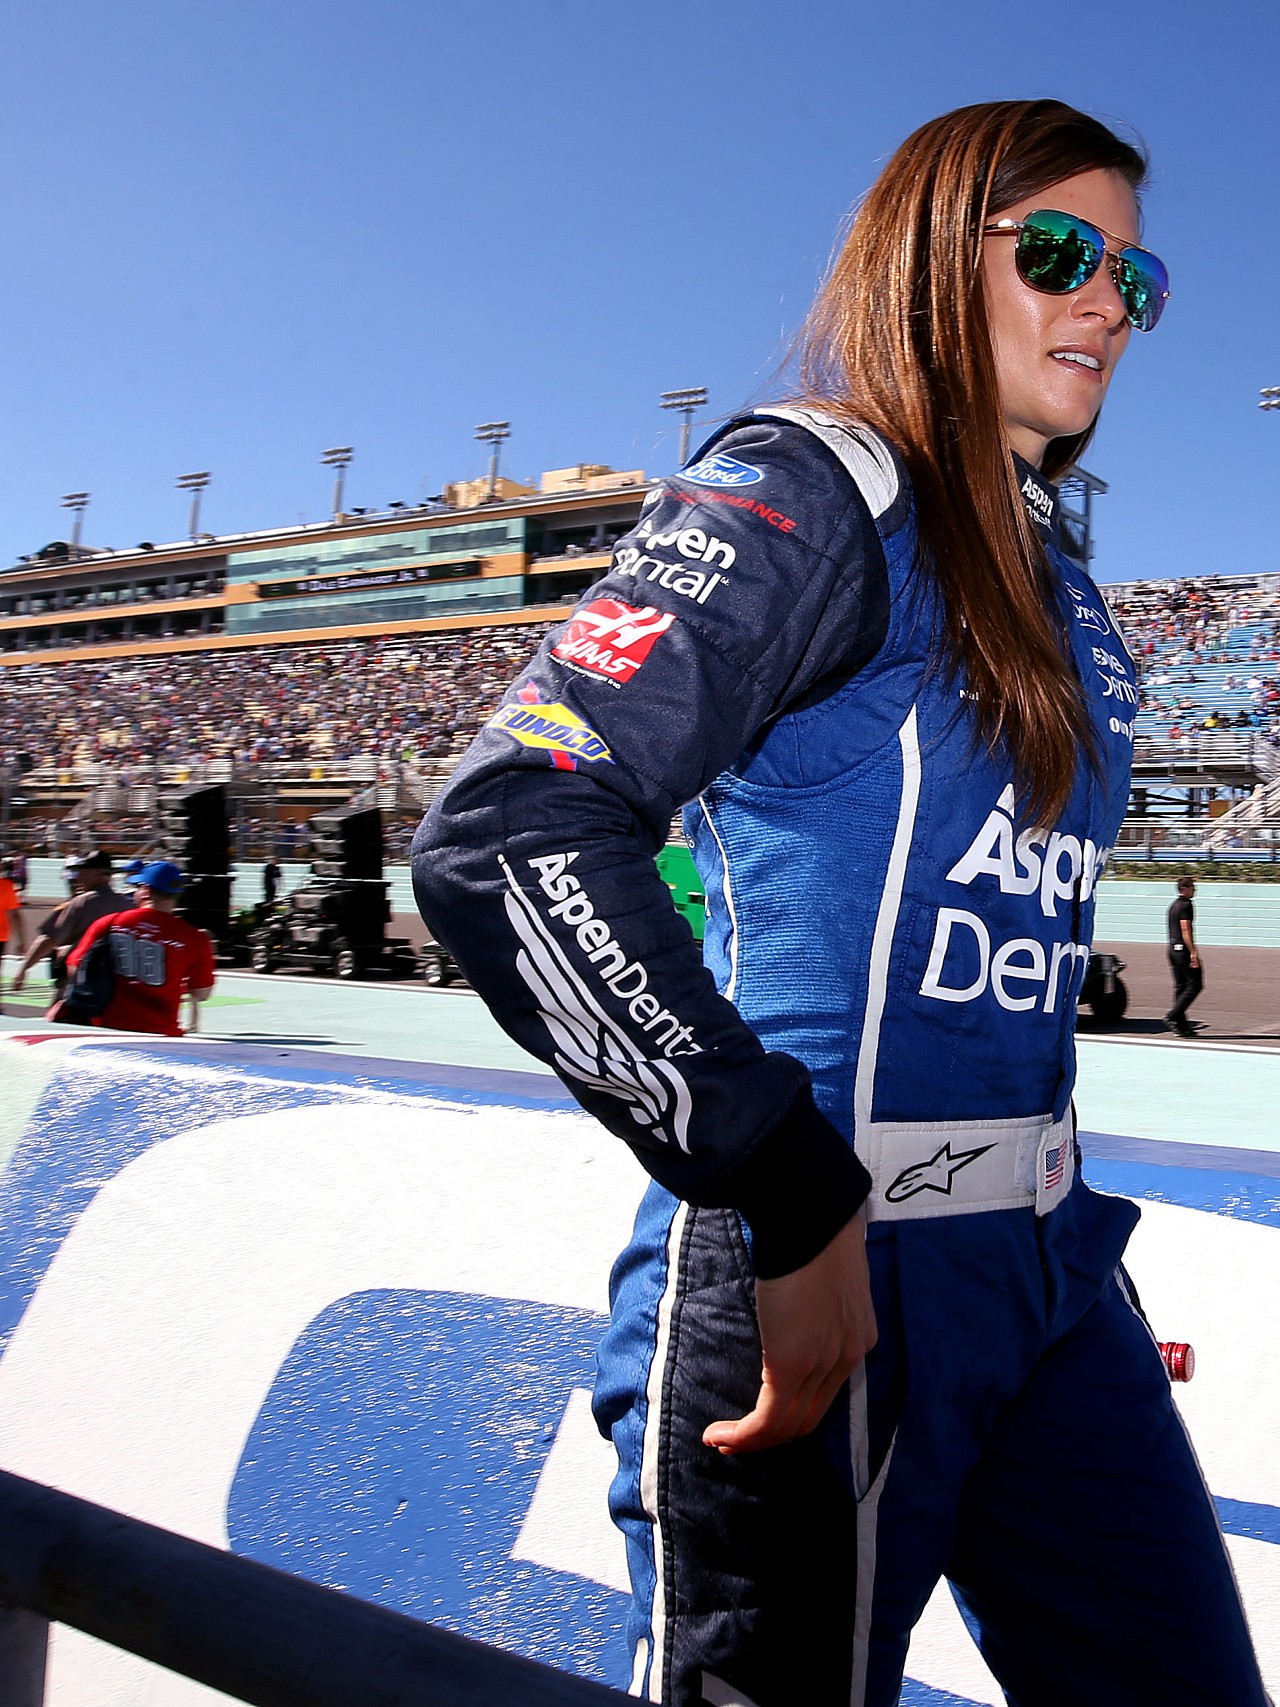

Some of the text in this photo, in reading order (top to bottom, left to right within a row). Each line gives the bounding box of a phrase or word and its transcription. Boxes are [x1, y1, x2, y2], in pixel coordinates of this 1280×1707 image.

[684, 456, 745, 484] Ford
[635, 519, 736, 570] pen
[558, 637, 642, 674] HAAS
[494, 707, 609, 757] SUNOCO
[527, 851, 712, 1058] AspenDent
